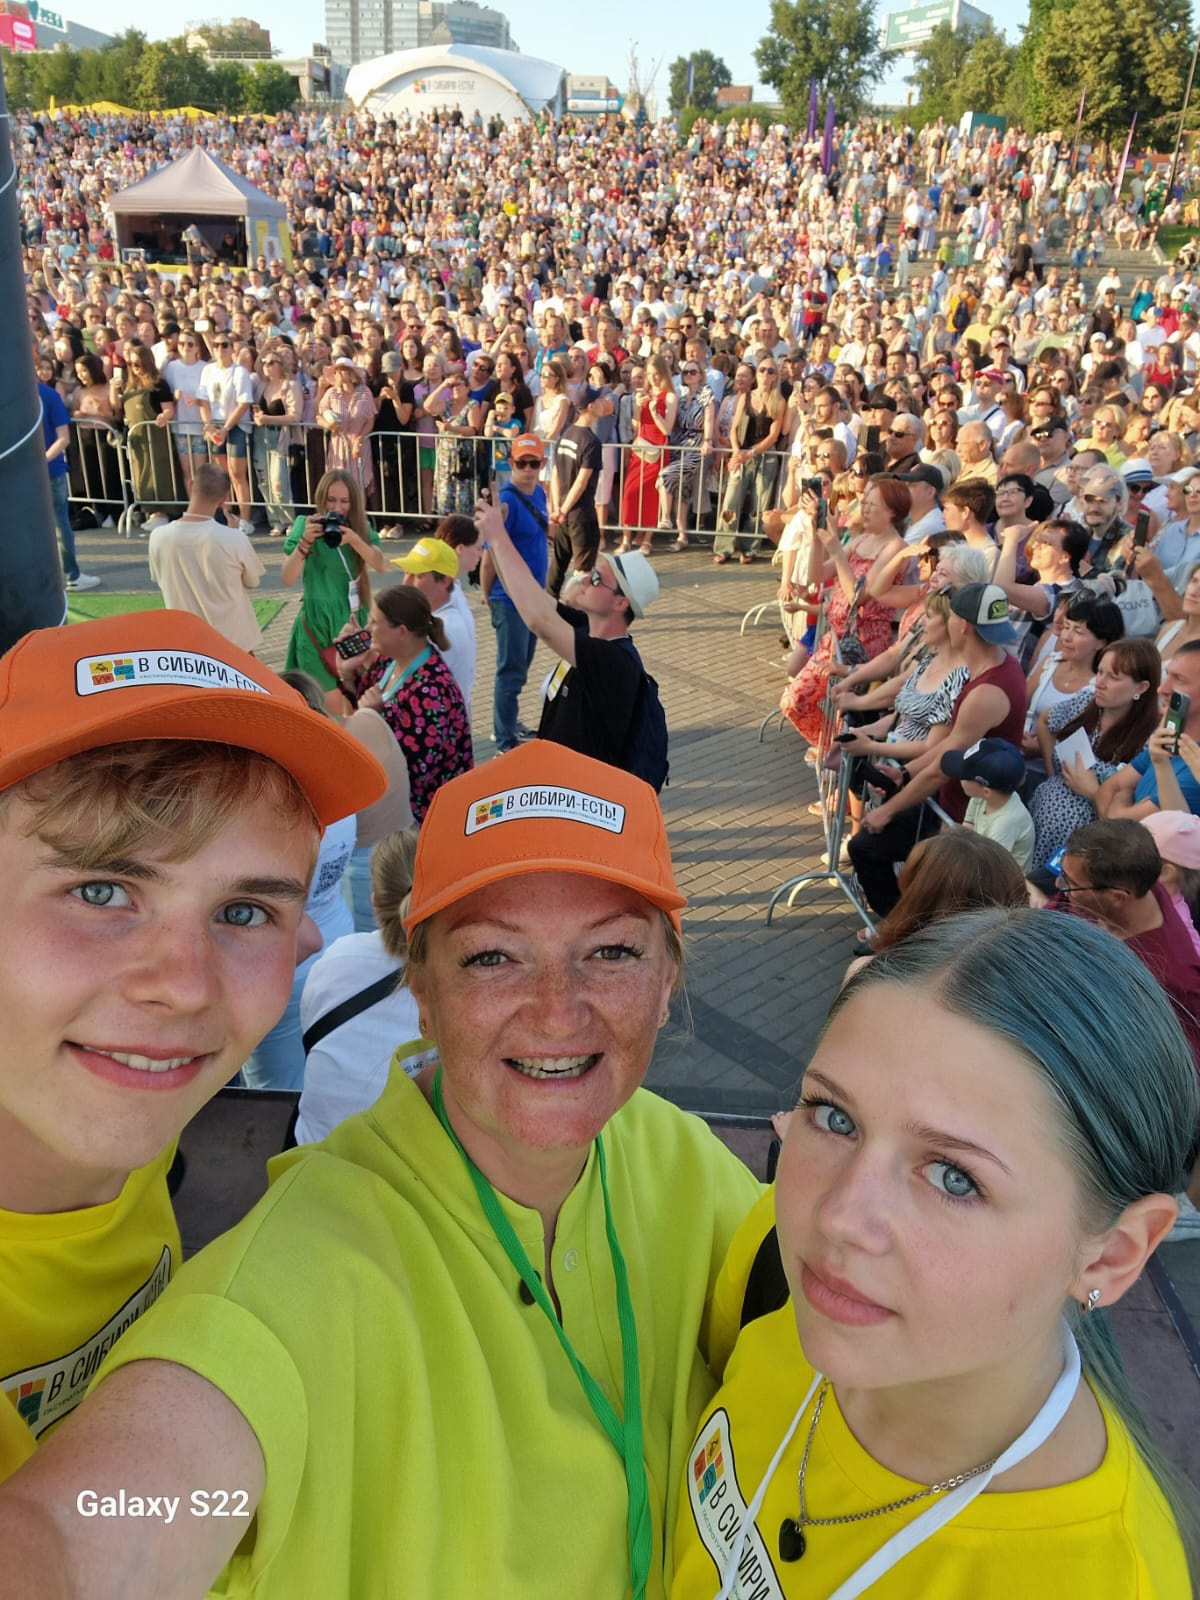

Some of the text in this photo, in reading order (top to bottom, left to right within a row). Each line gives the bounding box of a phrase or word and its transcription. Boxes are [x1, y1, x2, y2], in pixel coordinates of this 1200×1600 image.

[138, 657, 150, 673] В
[506, 795, 515, 810] В
[519, 791, 616, 821] СИБИРИ-ЕСТЬ!
[47, 1371, 65, 1403] В
[709, 1480, 727, 1509] В
